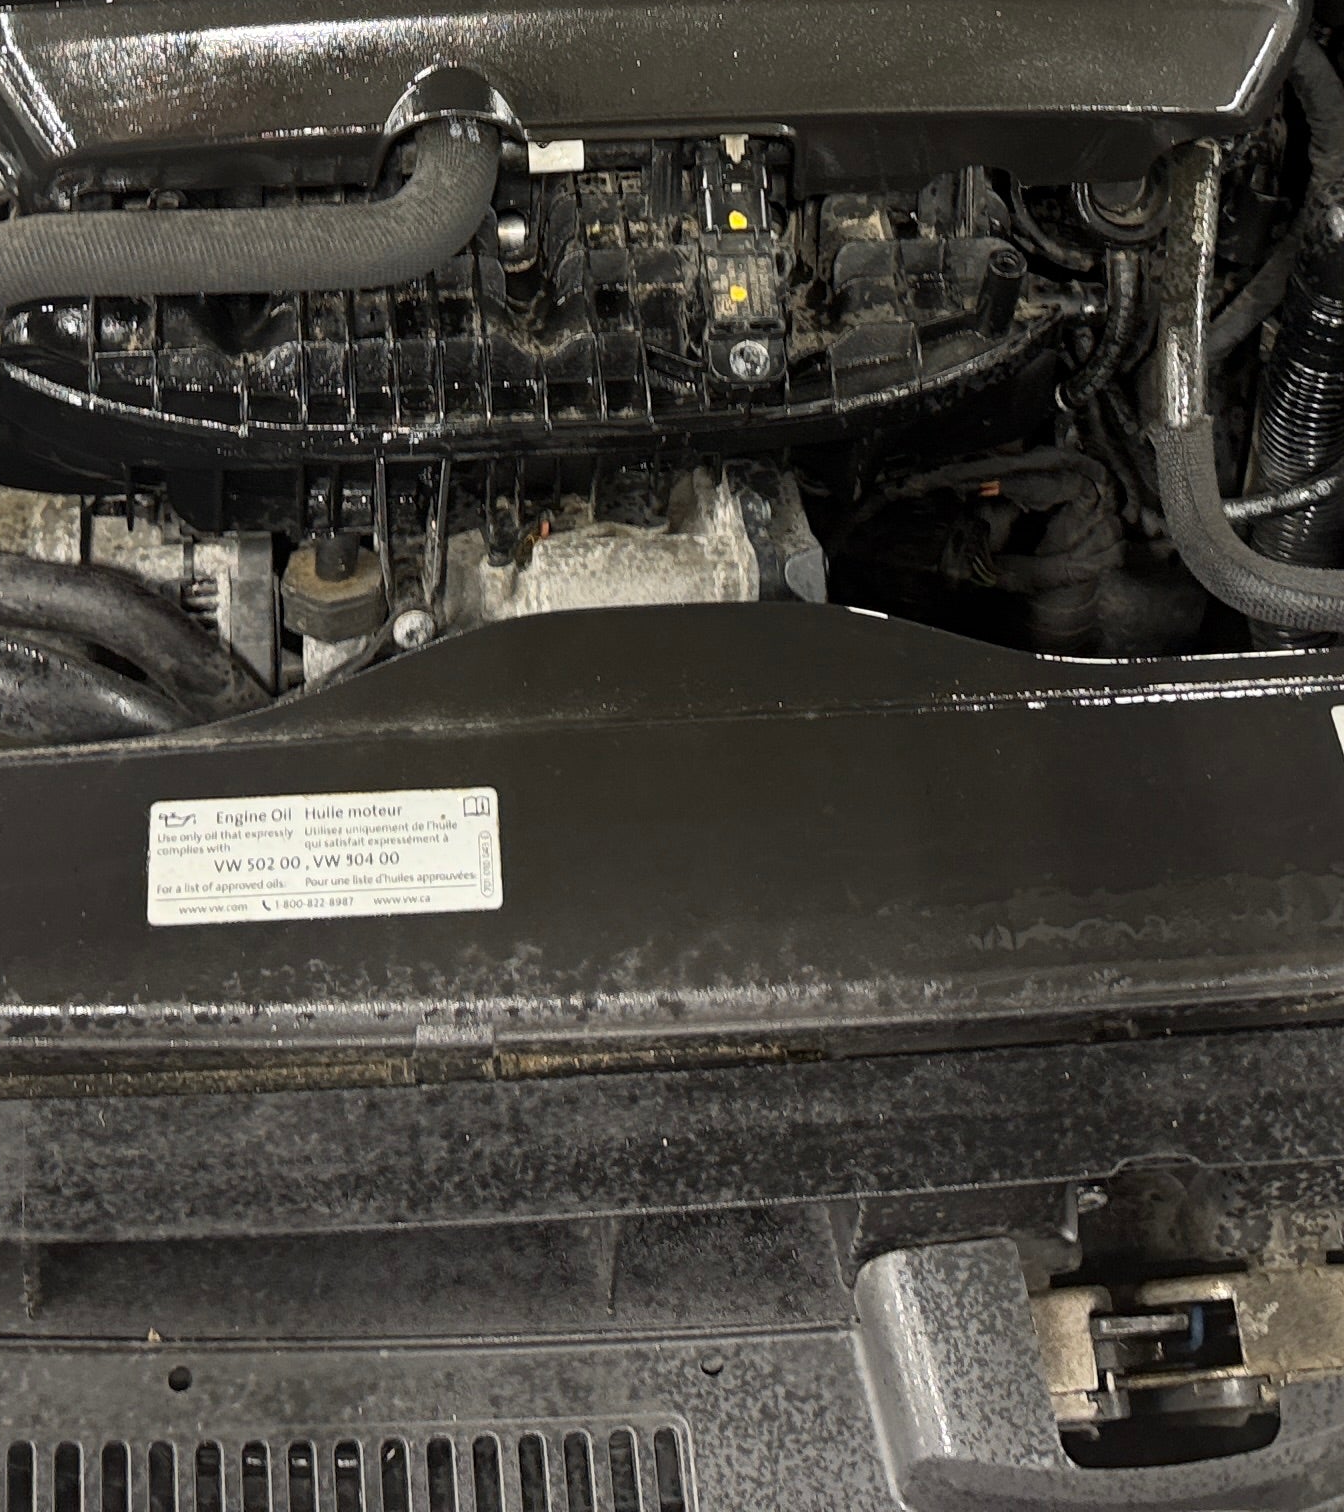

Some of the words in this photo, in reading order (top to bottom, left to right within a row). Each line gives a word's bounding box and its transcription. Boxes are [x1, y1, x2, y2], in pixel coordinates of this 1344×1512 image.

[216, 809, 266, 826] Engine
[271, 807, 291, 821] Oil
[305, 806, 344, 820] Huile
[348, 804, 402, 818] moteur
[157, 833, 176, 843] Use
[179, 831, 202, 845] only
[204, 831, 217, 841] oil
[220, 830, 241, 840] that
[245, 827, 293, 842] expressly
[304, 825, 342, 836] Utilisez
[345, 822, 409, 837] uniquement
[411, 821, 424, 831] de
[426, 819, 457, 830] l'huile
[157, 844, 203, 858] complies
[206, 842, 230, 853] with
[305, 839, 321, 850] qui
[324, 836, 364, 848] satisfait
[368, 833, 439, 847] expressément
[442, 832, 448, 842] à
[213, 859, 241, 873] VW
[247, 857, 274, 871] 502
[280, 856, 300, 869] 00
[313, 854, 340, 868] VW
[379, 850, 399, 864] 00
[156, 883, 173, 894] For
[183, 882, 199, 893] list
[202, 881, 212, 892] of
[216, 879, 263, 894] approved
[305, 876, 326, 887] Pour
[331, 877, 348, 886] une
[353, 874, 373, 884] liste
[375, 871, 414, 883] d'huiles
[178, 901, 247, 915] www.vw.com
[373, 892, 430, 905] www.vw.ca
